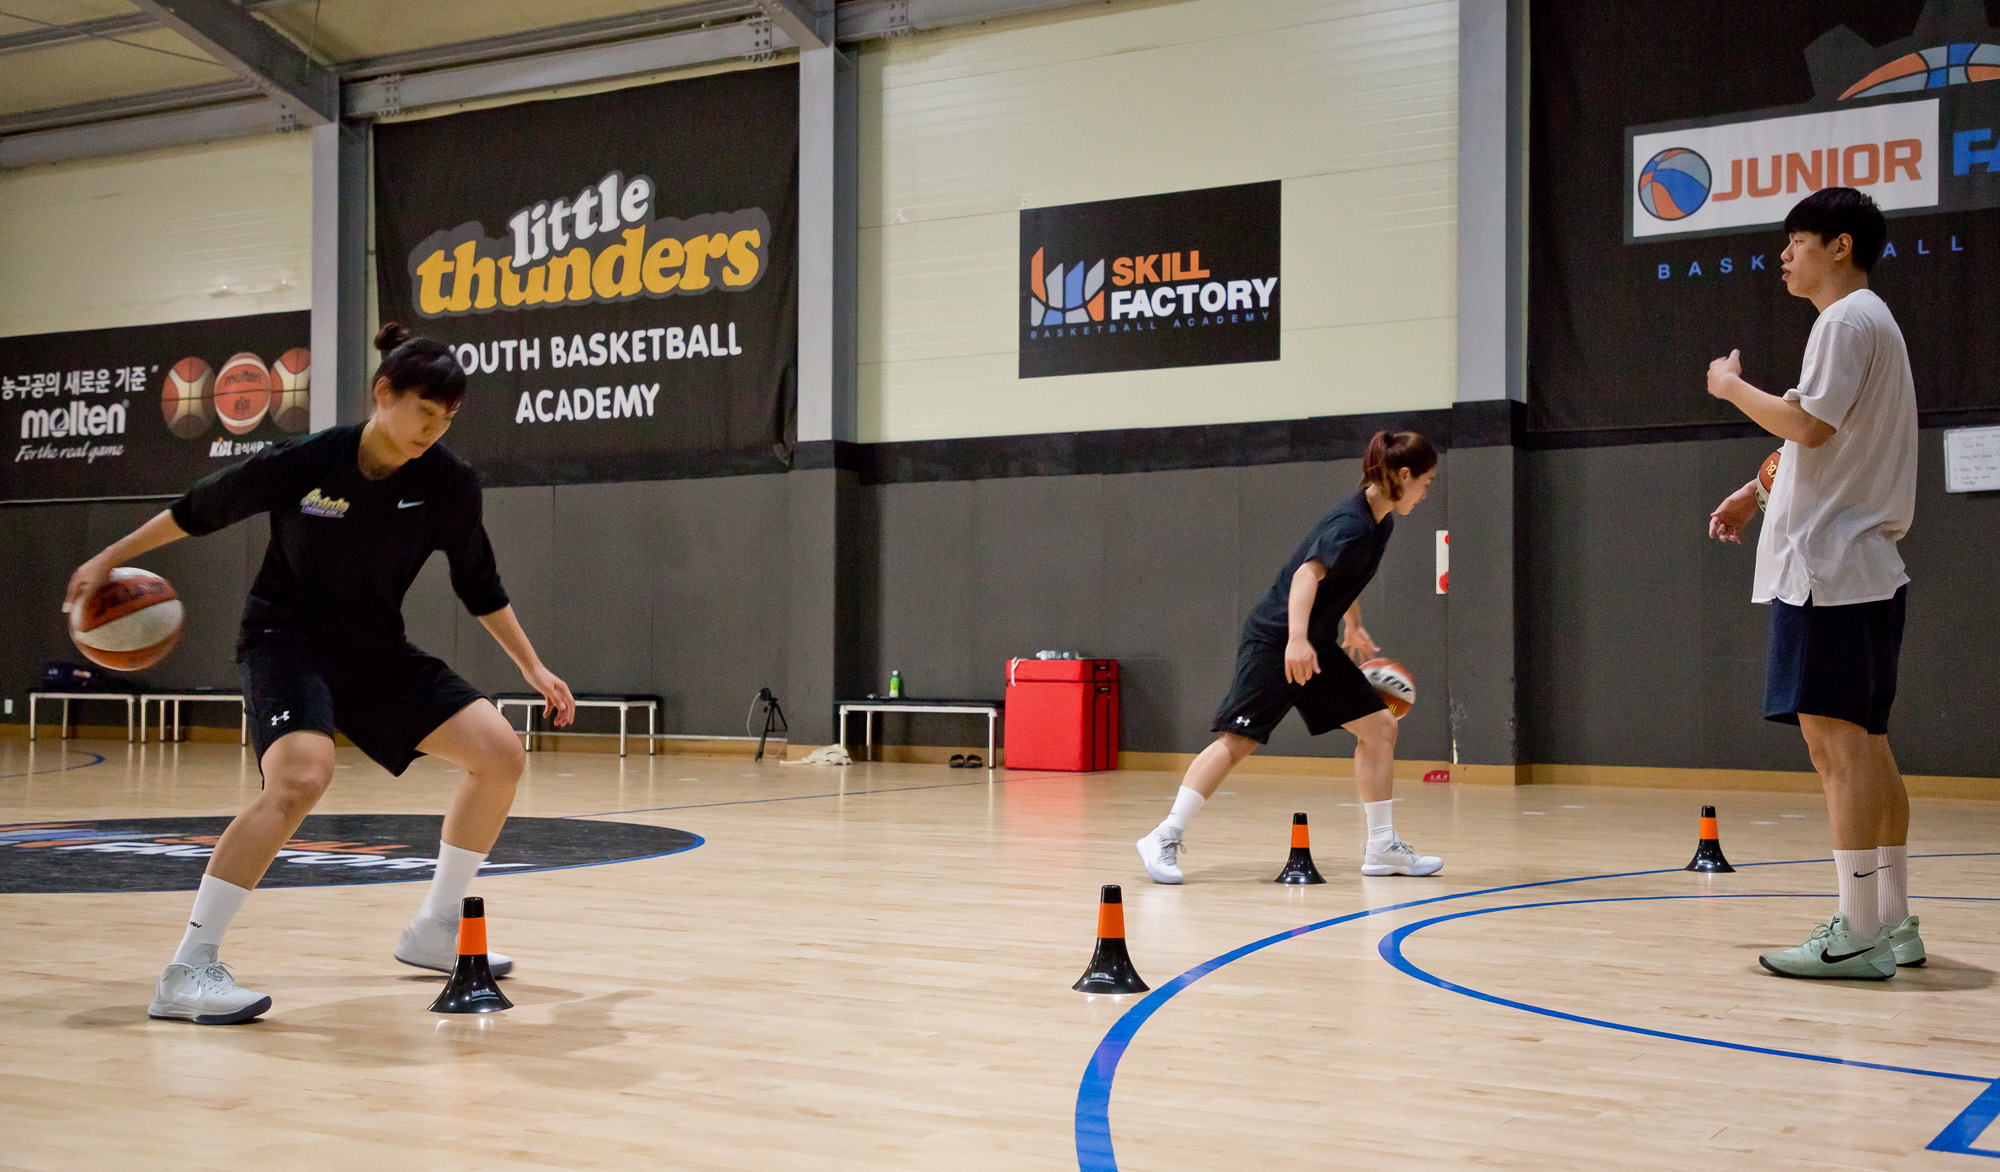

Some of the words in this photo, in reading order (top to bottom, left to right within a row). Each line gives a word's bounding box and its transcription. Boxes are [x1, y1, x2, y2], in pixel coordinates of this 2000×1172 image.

[1711, 138, 1923, 203] JUNIOR
[509, 173, 651, 268] little
[416, 223, 761, 315] thunders
[1111, 250, 1210, 287] SKILL
[1110, 277, 1278, 321] FACTORY
[1030, 322, 1157, 340] BASKETBALL
[1173, 311, 1270, 328] ACADEMY
[448, 337, 541, 376] OUTH
[550, 321, 742, 369] BASKETBALL
[1, 371, 61, 400] 농구공의
[64, 368, 112, 395] 새로운
[515, 382, 660, 424] ACADEMY
[154, 835, 411, 855] SILL
